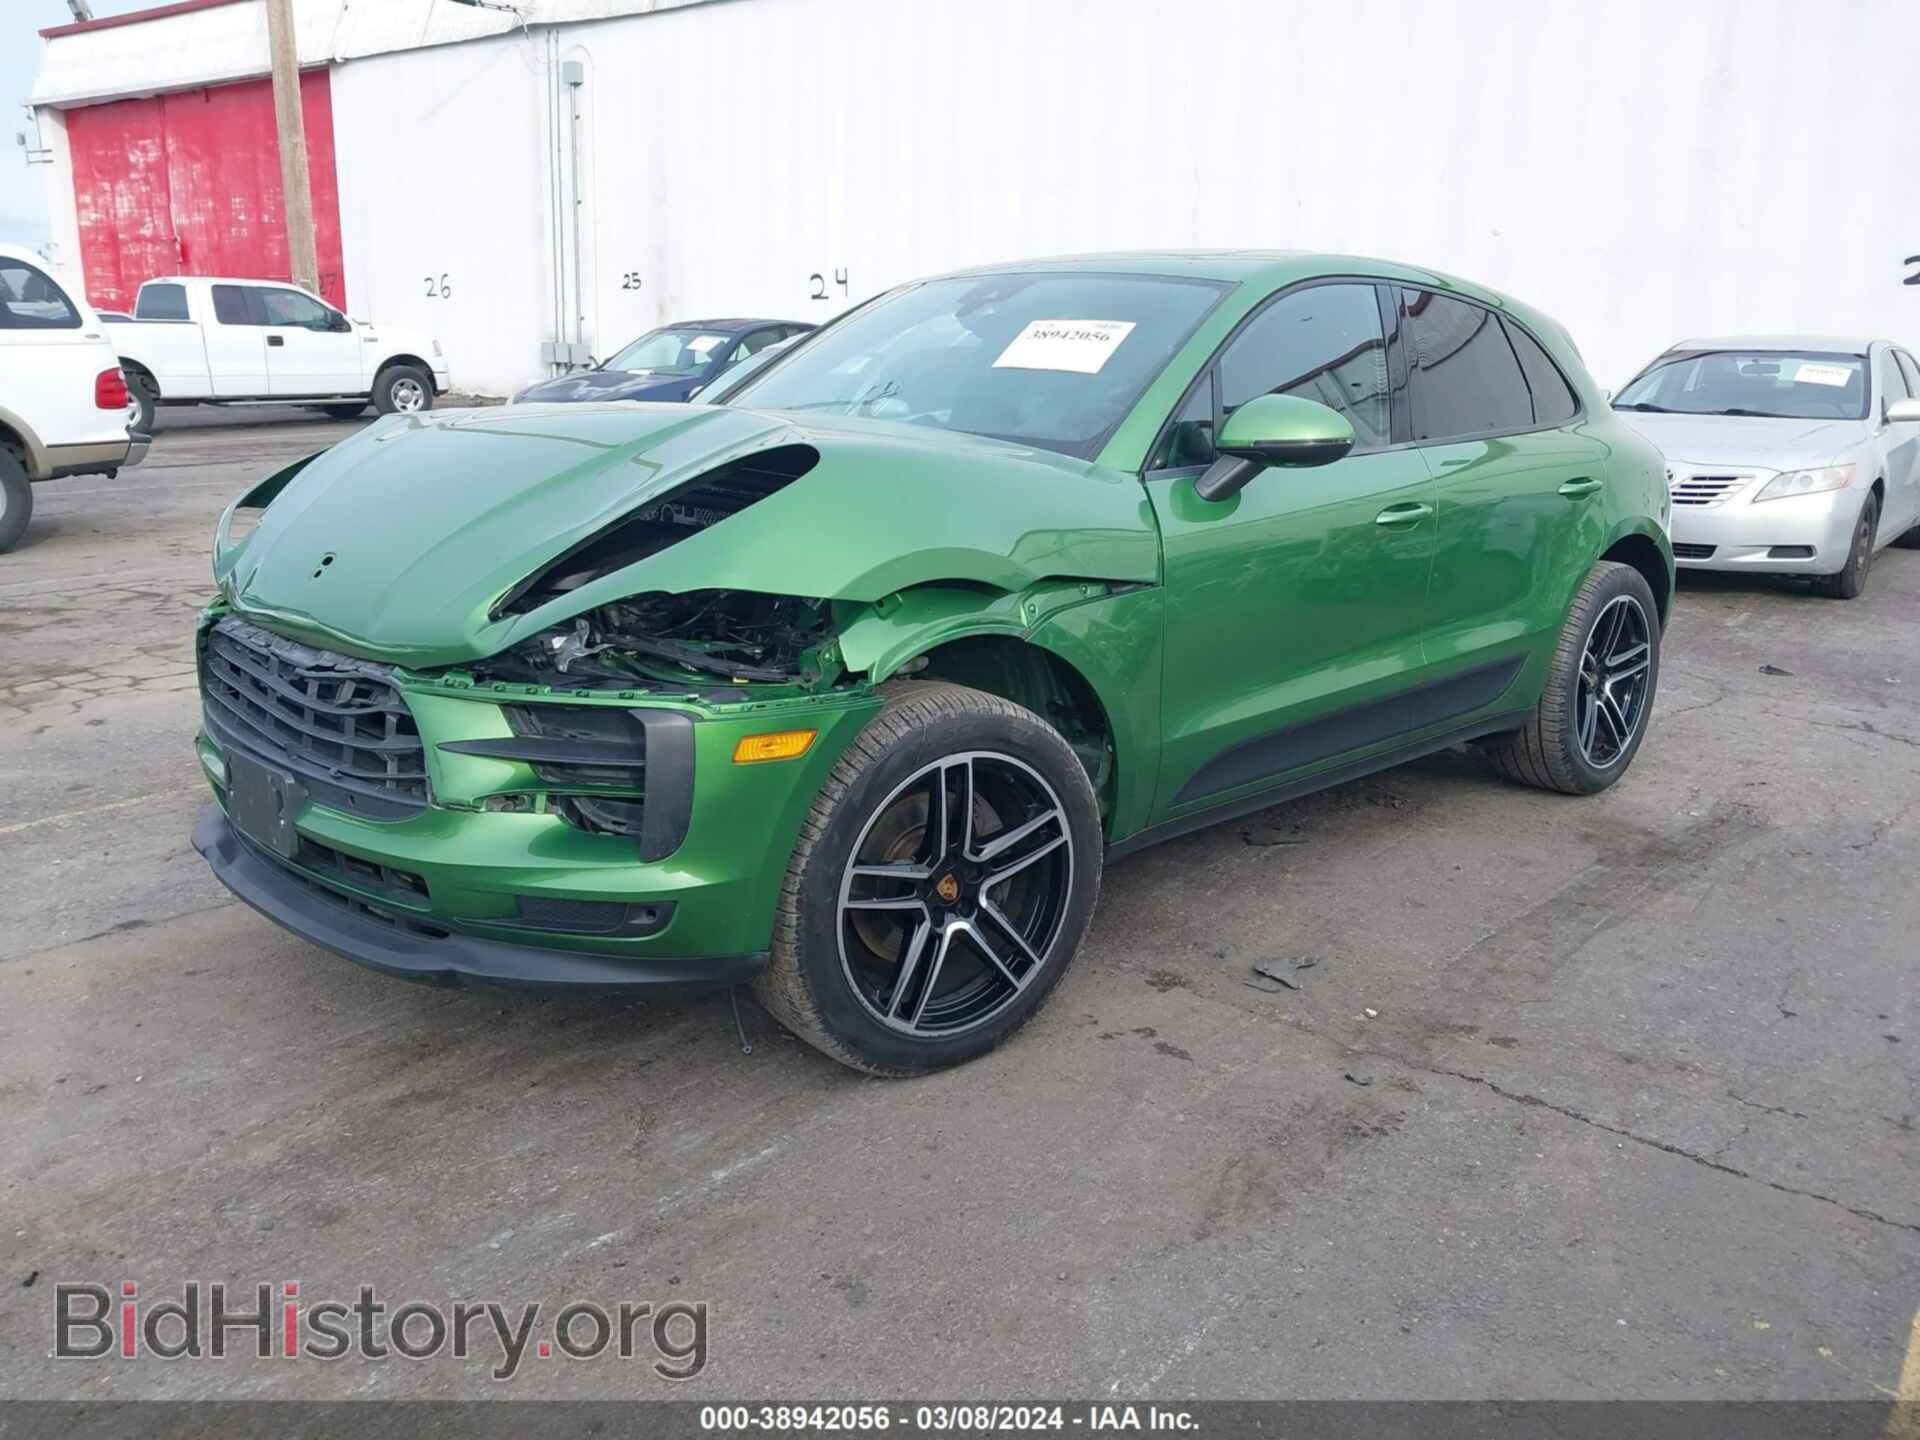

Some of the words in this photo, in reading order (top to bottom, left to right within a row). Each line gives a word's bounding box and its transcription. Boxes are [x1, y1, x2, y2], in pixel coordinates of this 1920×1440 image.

[424, 273, 451, 299] 26
[621, 272, 642, 290] 25
[809, 268, 849, 300] 24
